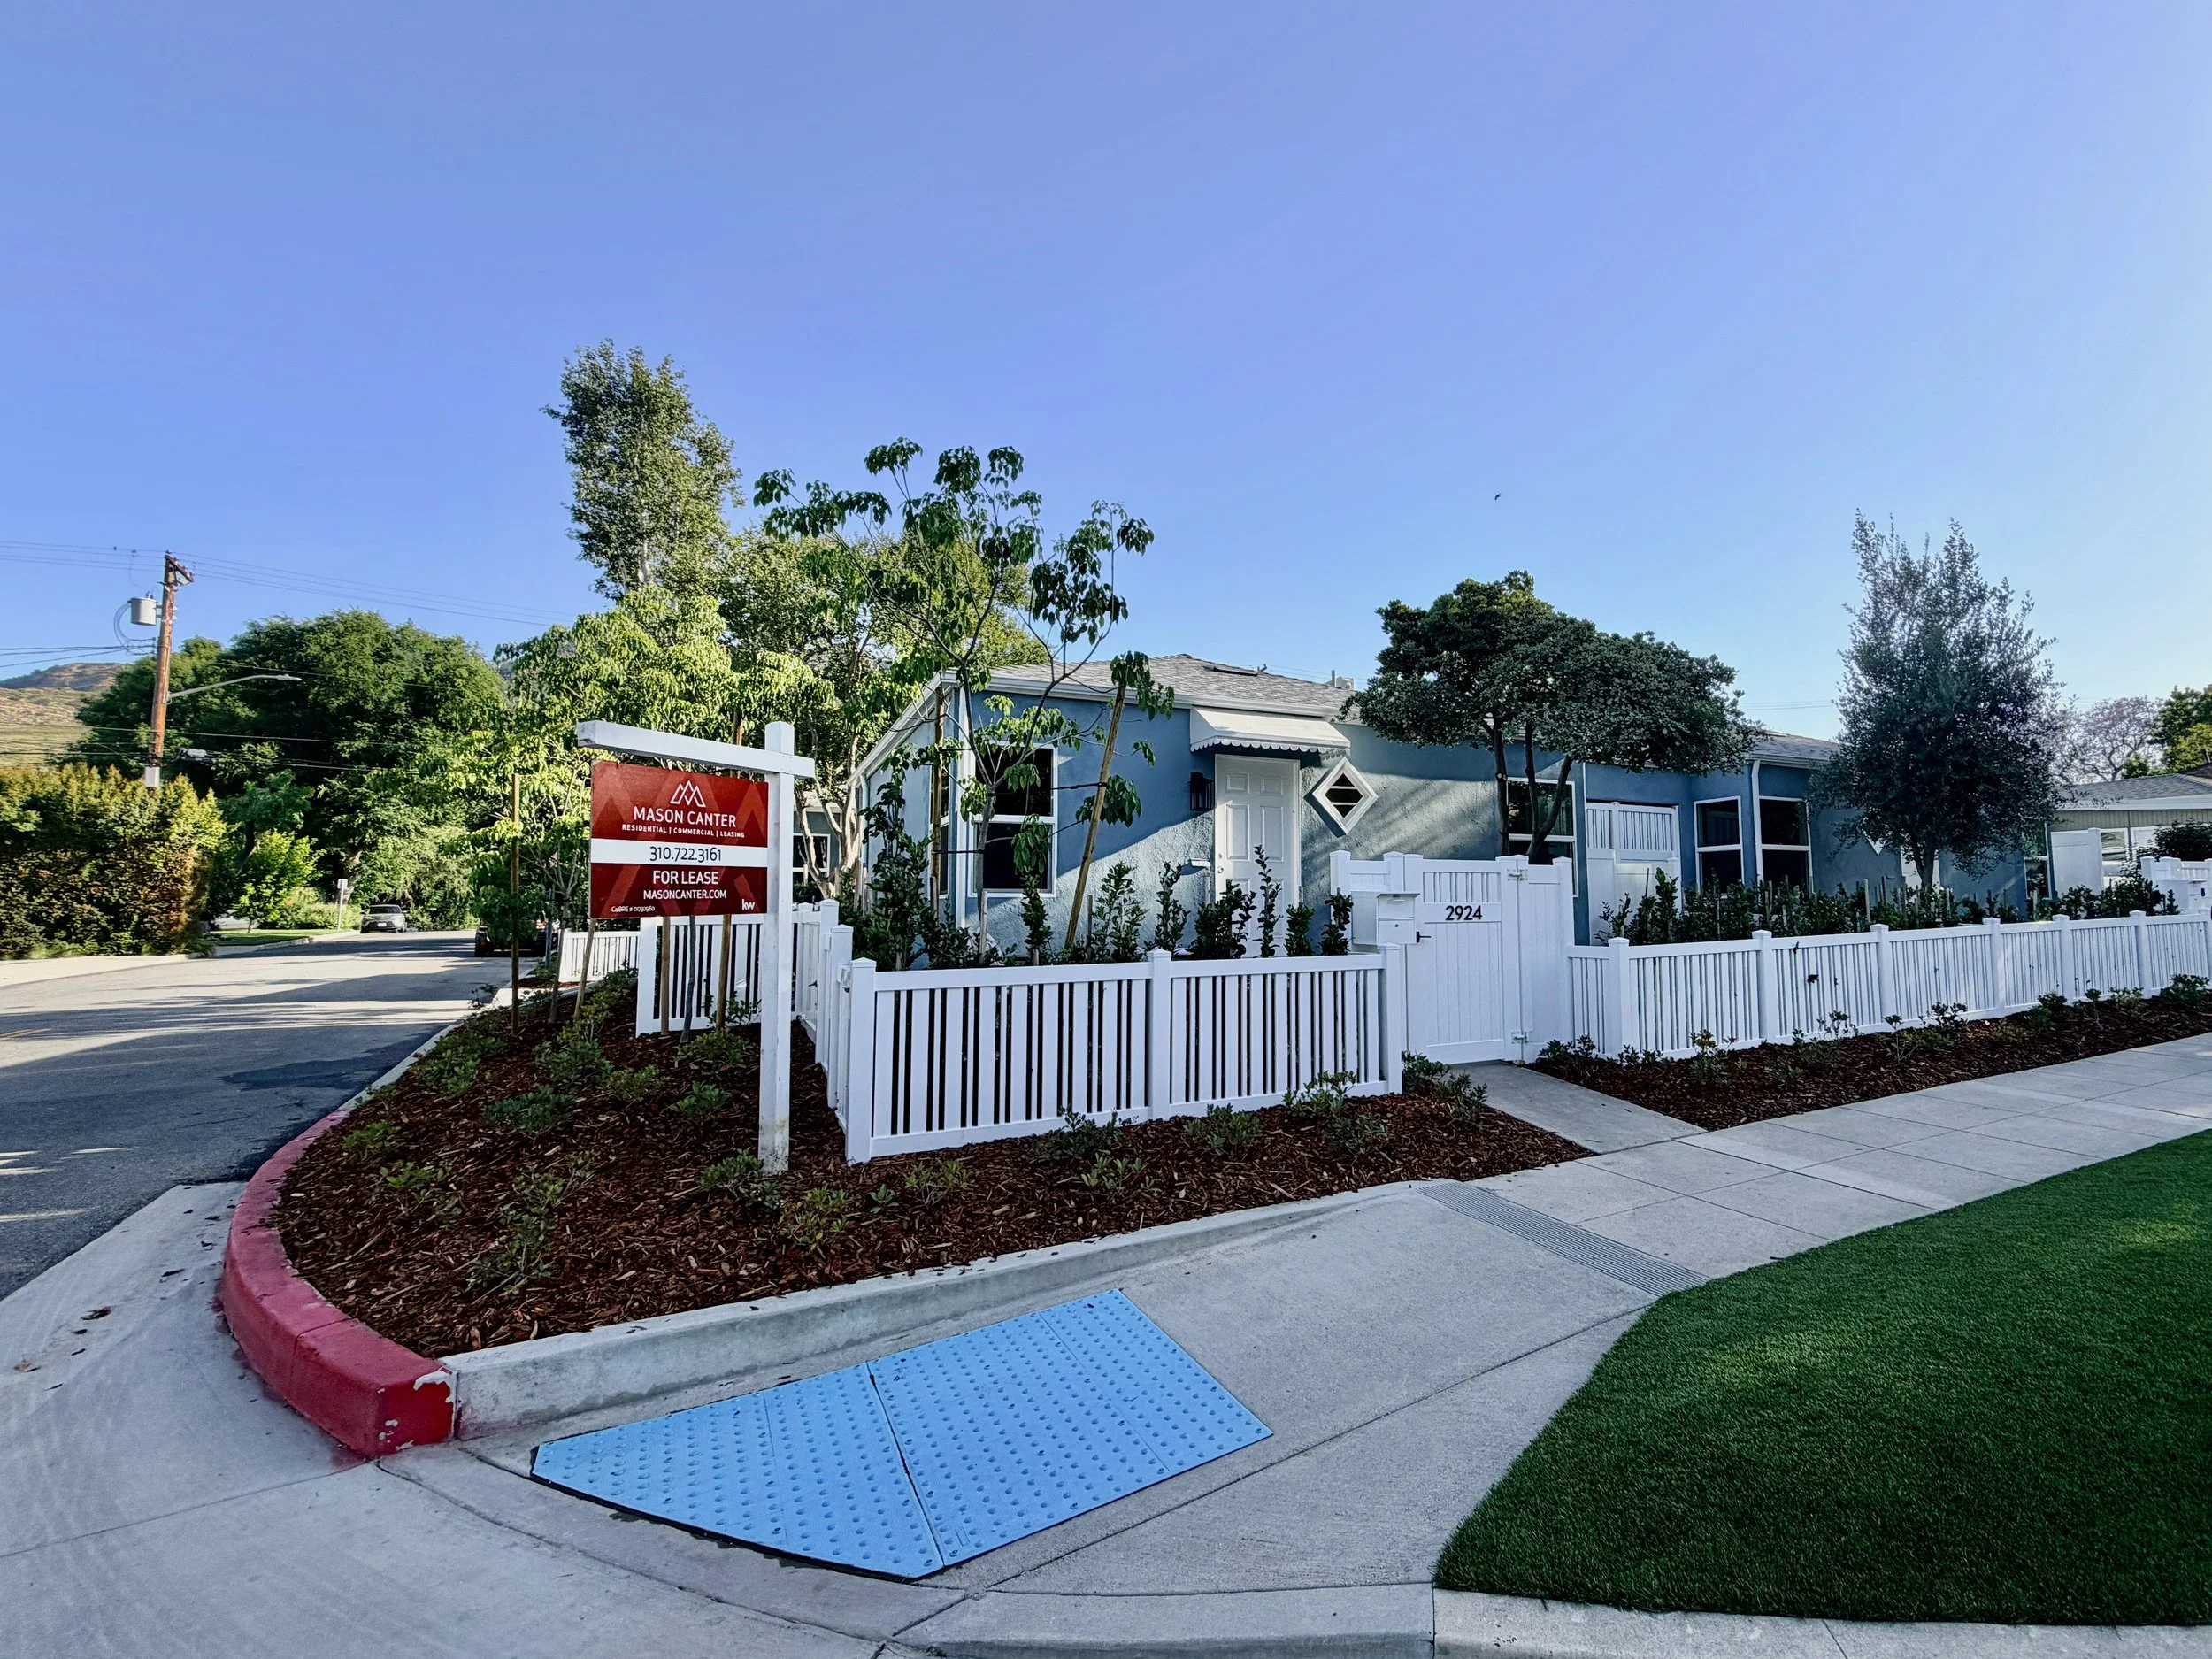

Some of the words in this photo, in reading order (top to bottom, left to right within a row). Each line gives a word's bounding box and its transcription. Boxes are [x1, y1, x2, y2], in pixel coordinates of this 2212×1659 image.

[634, 806, 683, 824] MASON
[687, 811, 736, 827] CANTER
[622, 824, 667, 833] RESIDENTIAL
[673, 827, 715, 837] COMMERCIAL
[649, 846, 722, 863] 310.722.3161
[653, 870, 679, 885] FOR
[681, 871, 719, 885] LEASE
[643, 889, 727, 900] MASONCANTER.COM
[741, 898, 756, 911] kw
[1445, 905, 1483, 921] 2924
